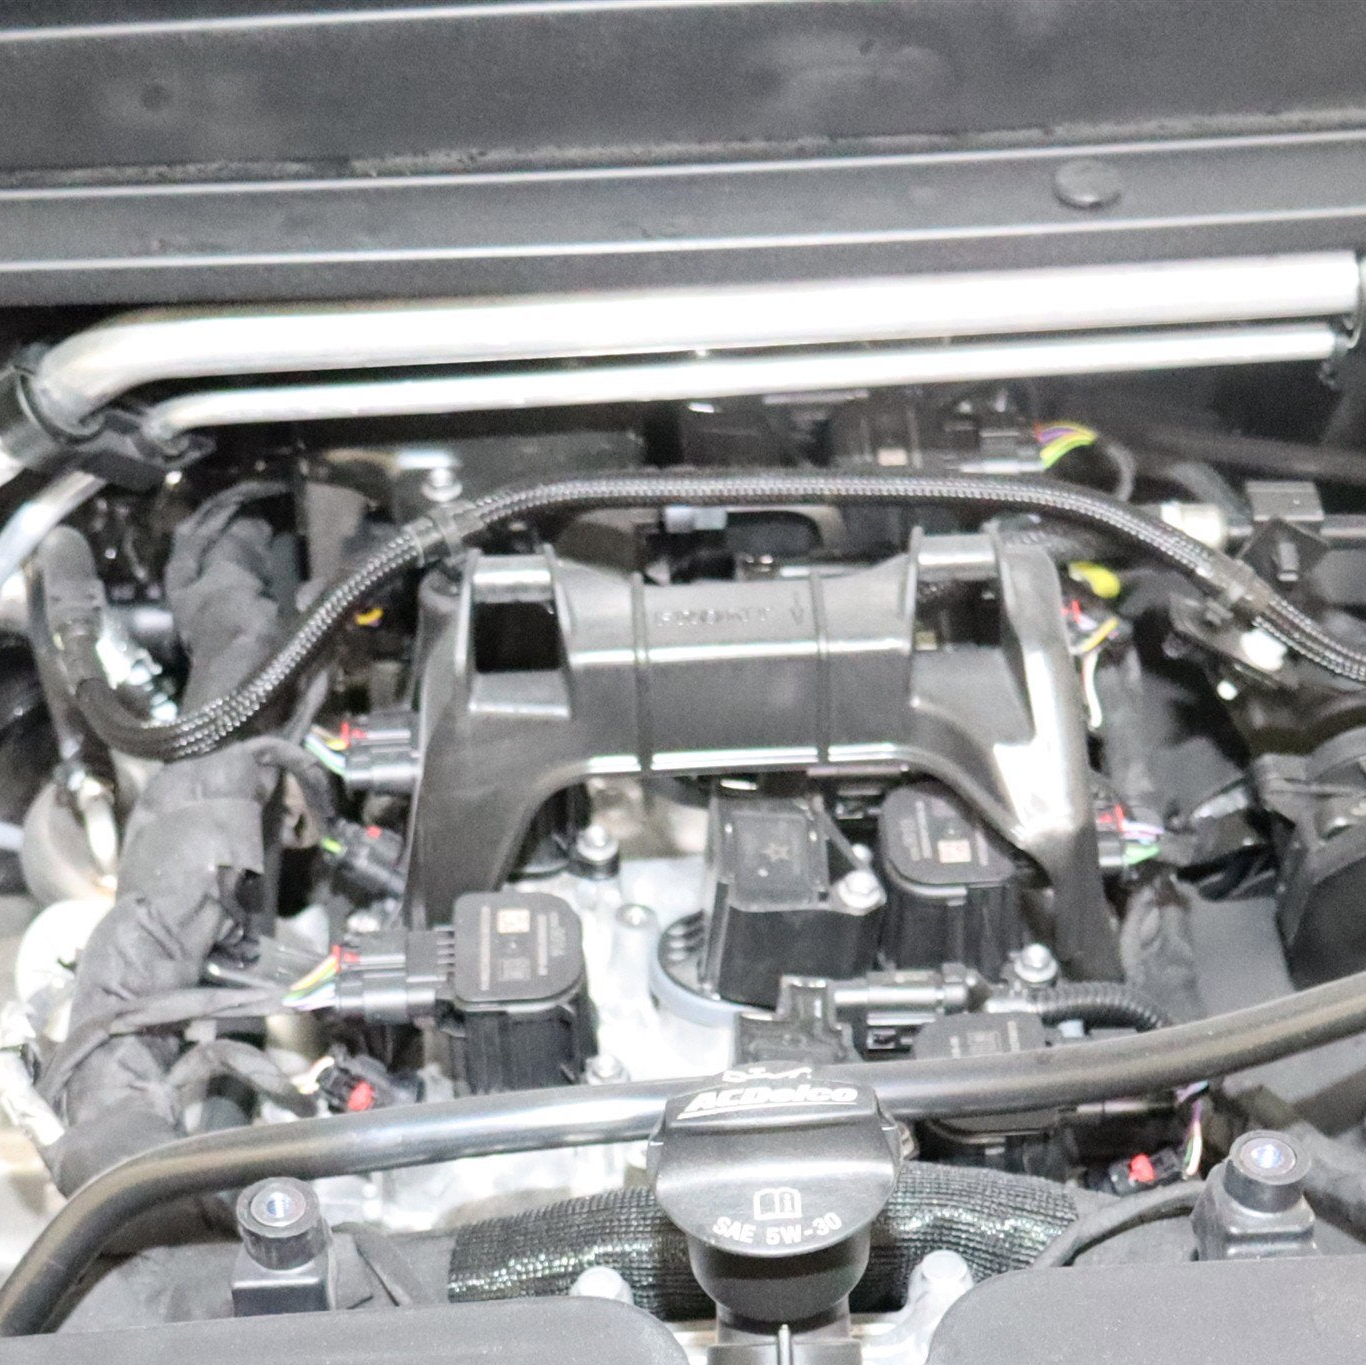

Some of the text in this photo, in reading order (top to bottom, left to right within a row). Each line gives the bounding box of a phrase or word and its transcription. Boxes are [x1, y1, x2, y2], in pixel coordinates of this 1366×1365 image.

[686, 1084, 858, 1112] ACDelco
[712, 1212, 843, 1245] SAE 5W-30
